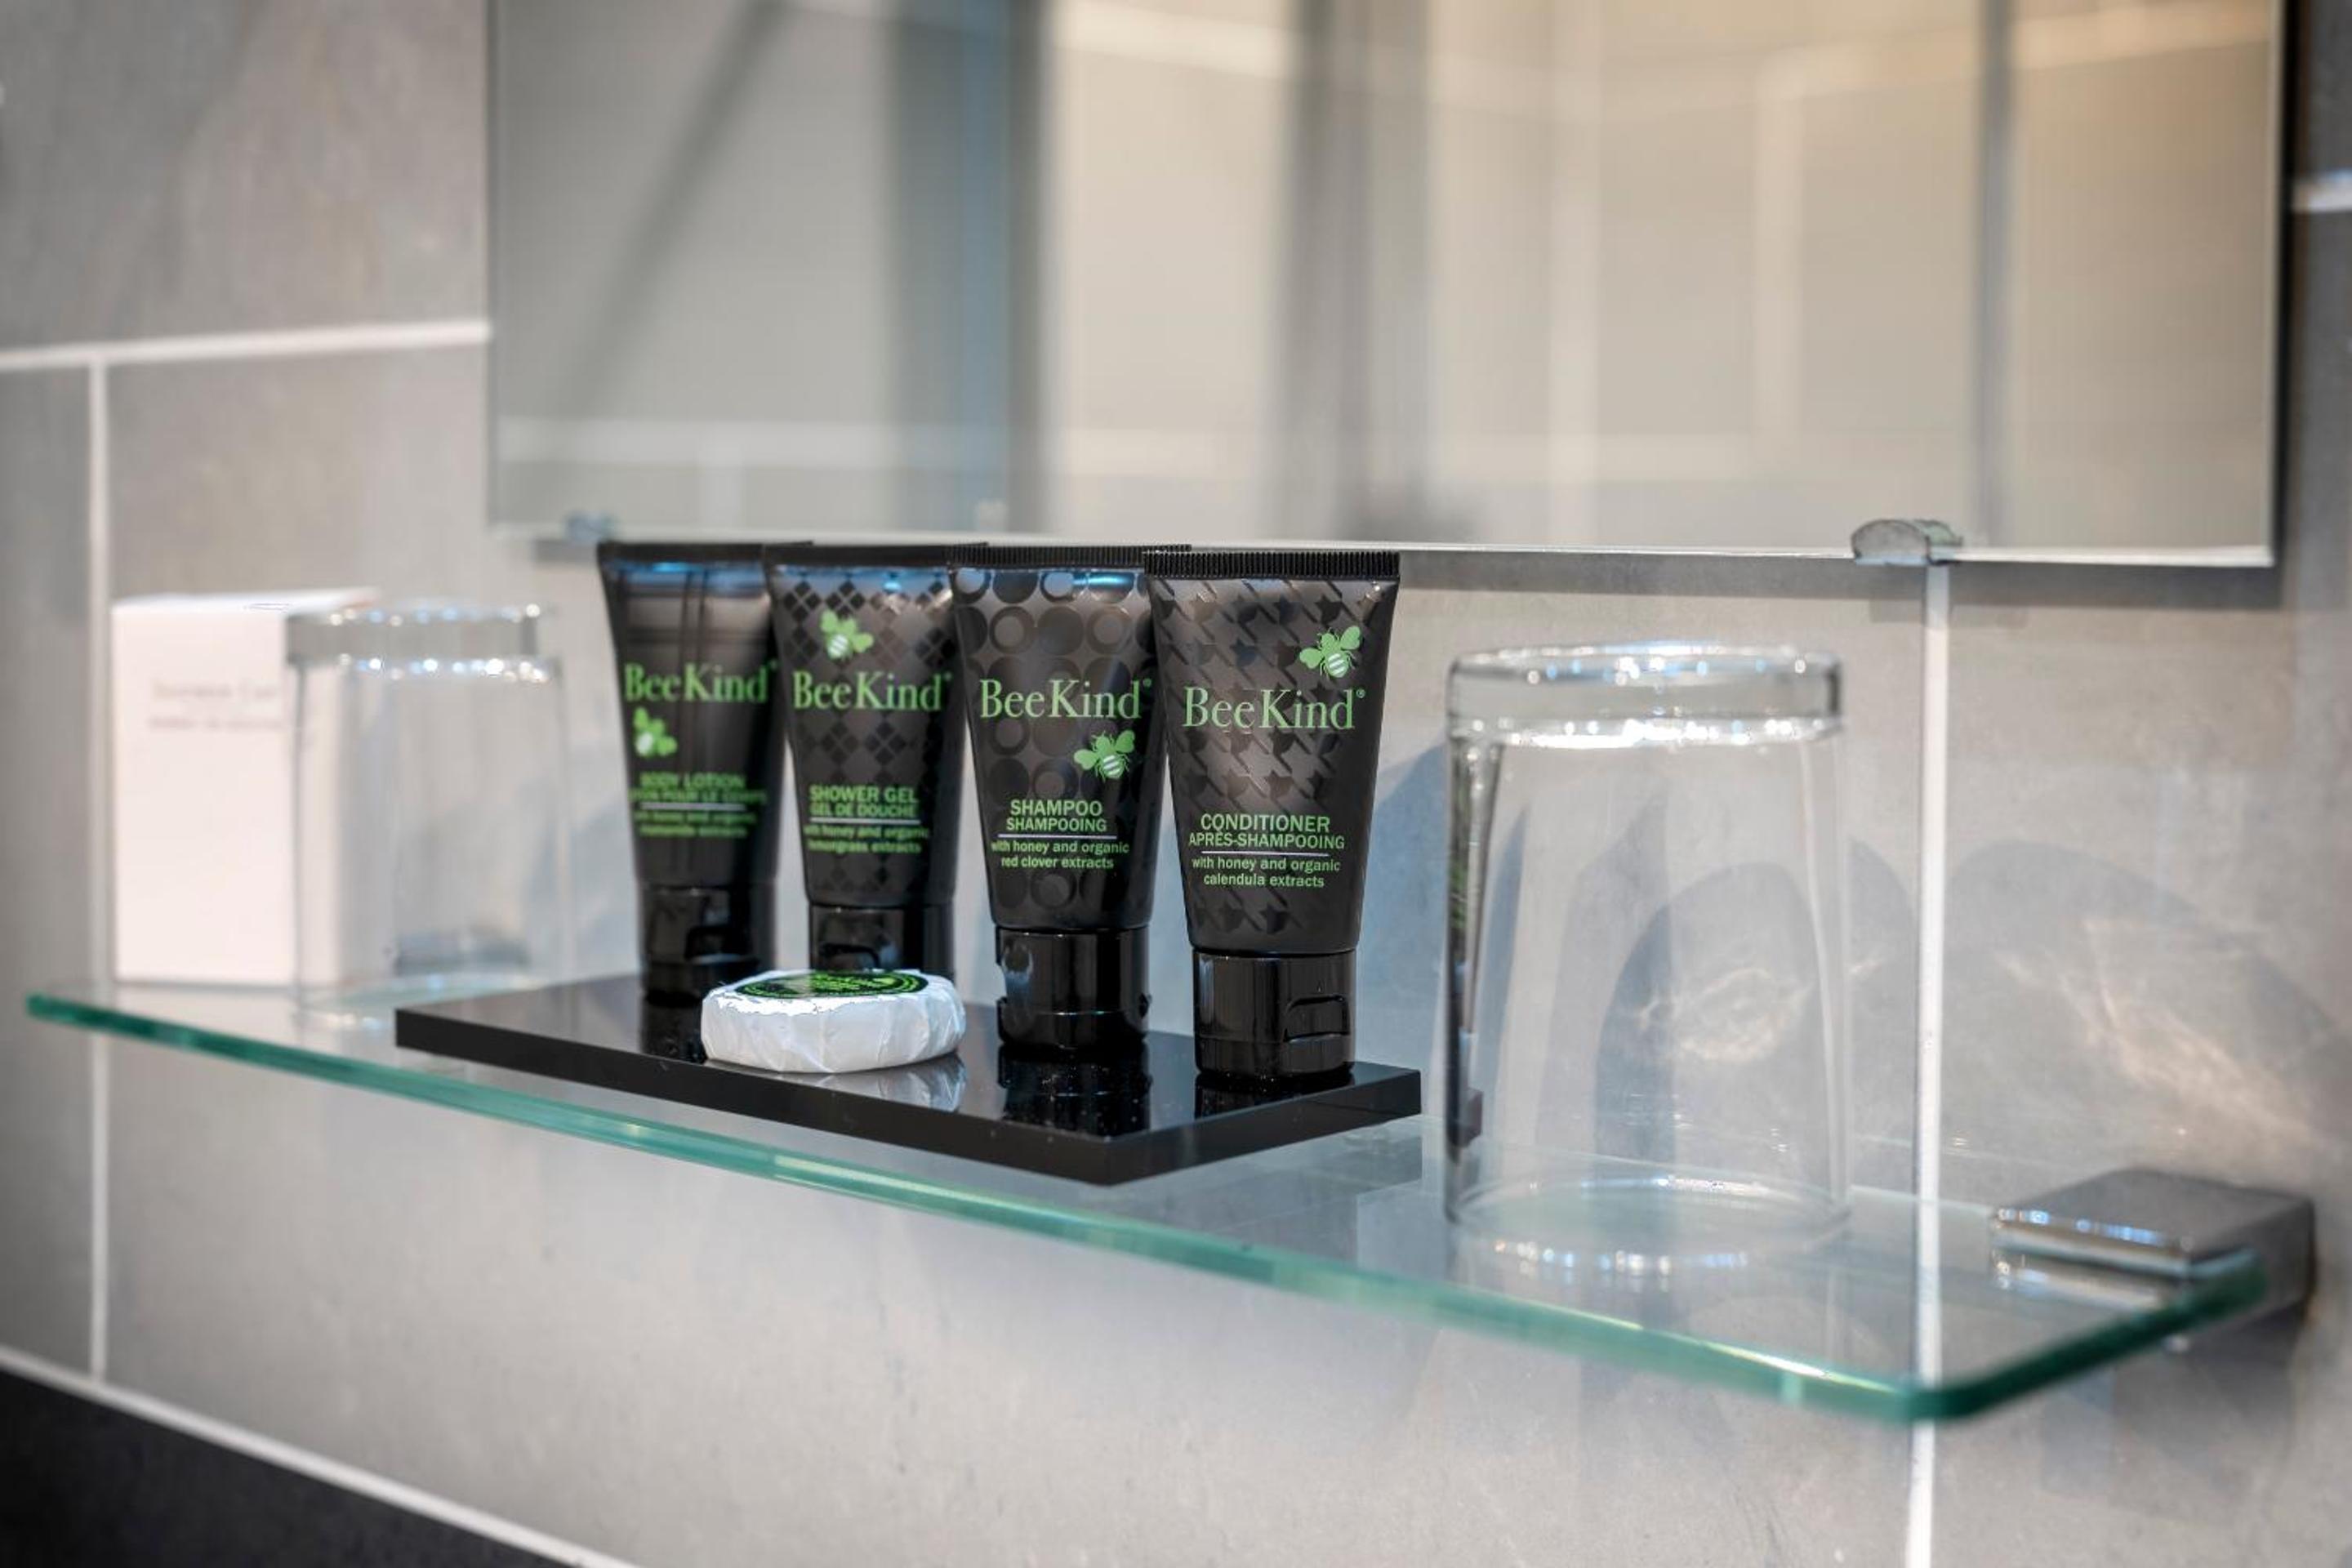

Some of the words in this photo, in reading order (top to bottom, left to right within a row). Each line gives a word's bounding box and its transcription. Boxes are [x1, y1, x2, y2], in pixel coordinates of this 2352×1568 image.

[810, 785, 880, 802] SHOWER
[884, 786, 918, 803] GEL
[857, 804, 916, 818] DOUCHE
[1010, 800, 1103, 817] SHAMPOO
[1006, 817, 1107, 832] SHAMPOOING
[1200, 813, 1331, 833] CONDITIONER
[991, 840, 1011, 853] with
[1013, 840, 1049, 855] honey
[1053, 841, 1078, 853] and
[1081, 843, 1130, 856] organic
[1001, 856, 1019, 868] red
[1020, 856, 1058, 868] clover
[1061, 858, 1115, 870] extracts
[1192, 857, 1215, 869] with
[1217, 858, 1257, 872] honey
[1260, 858, 1287, 871] and
[1290, 859, 1342, 874] organic
[1203, 872, 1266, 886] calendula
[1269, 874, 1325, 888] extracts
